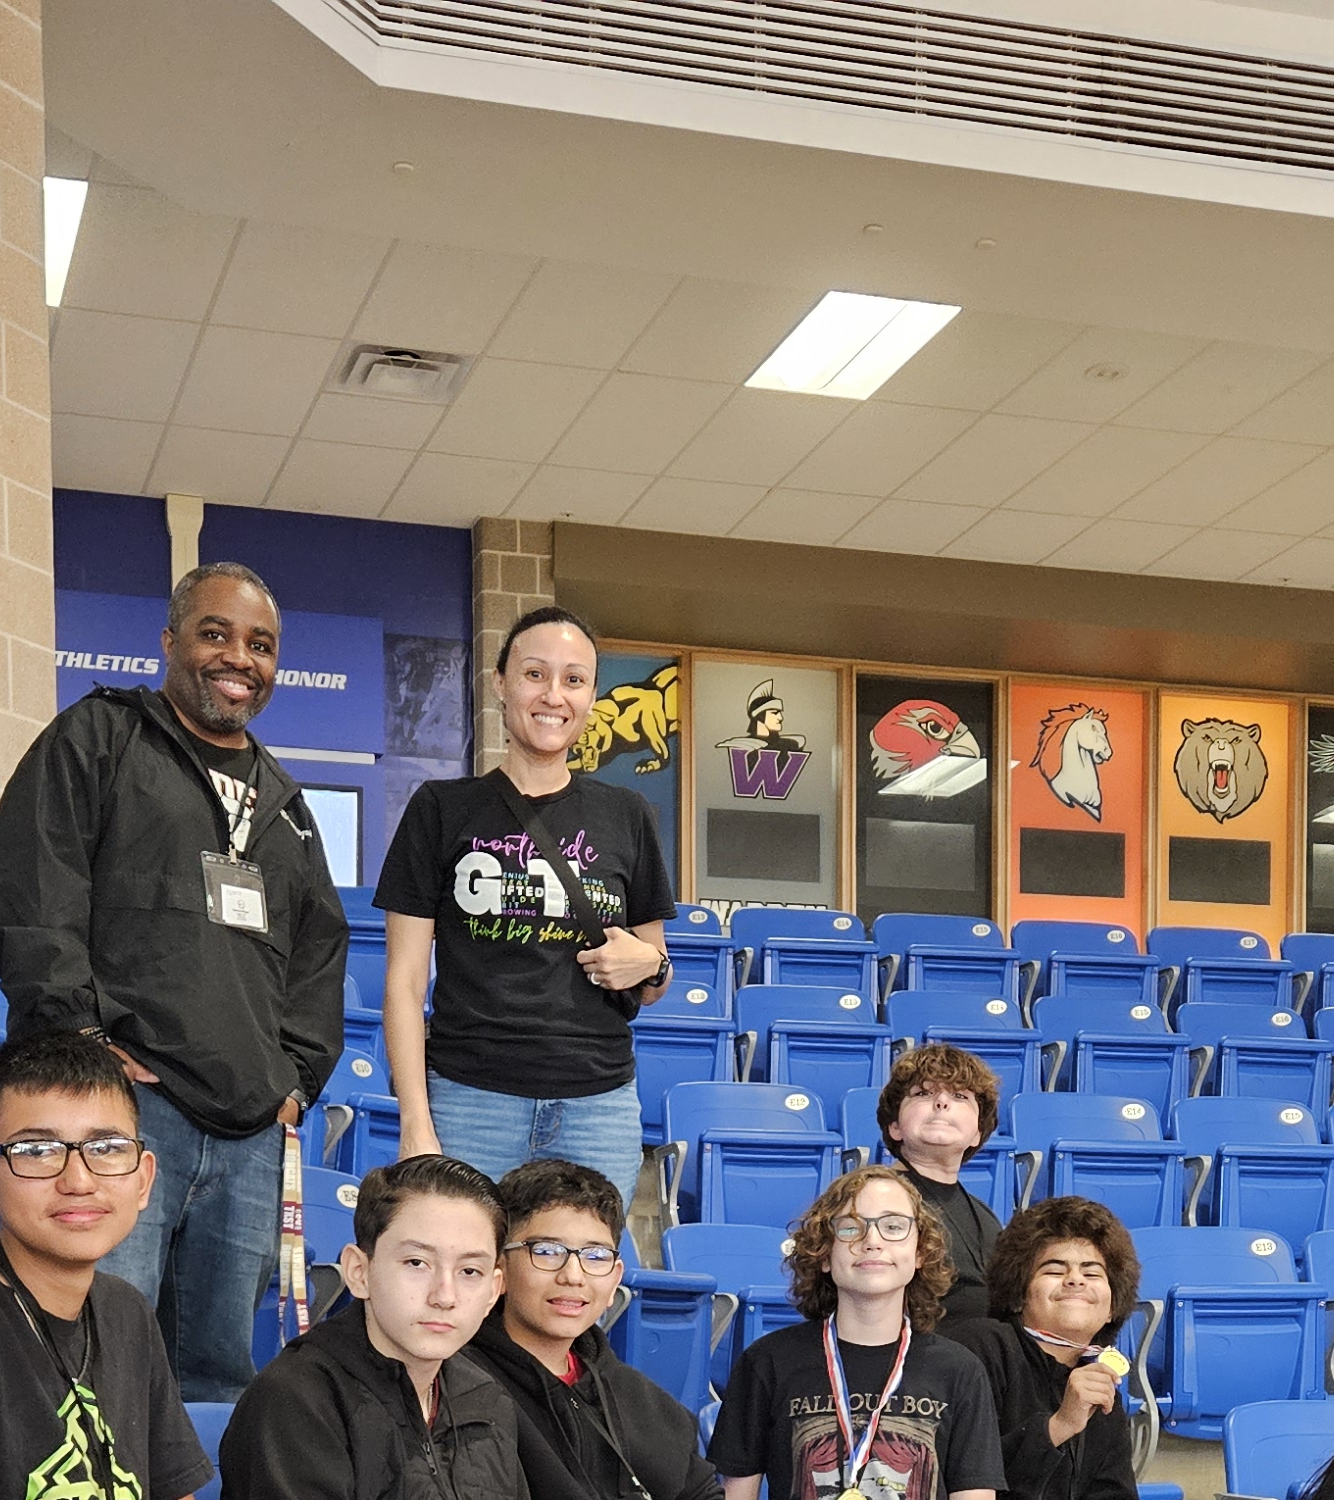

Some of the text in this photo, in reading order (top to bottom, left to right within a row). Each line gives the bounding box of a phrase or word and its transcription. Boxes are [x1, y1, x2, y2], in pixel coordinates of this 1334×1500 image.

[55, 650, 159, 675] THLETICS
[728, 747, 812, 800] W
[453, 851, 502, 916] G
[506, 918, 534, 944] big
[1255, 1242, 1273, 1251] E13
[788, 1393, 949, 1419] FALL OUT BOY
